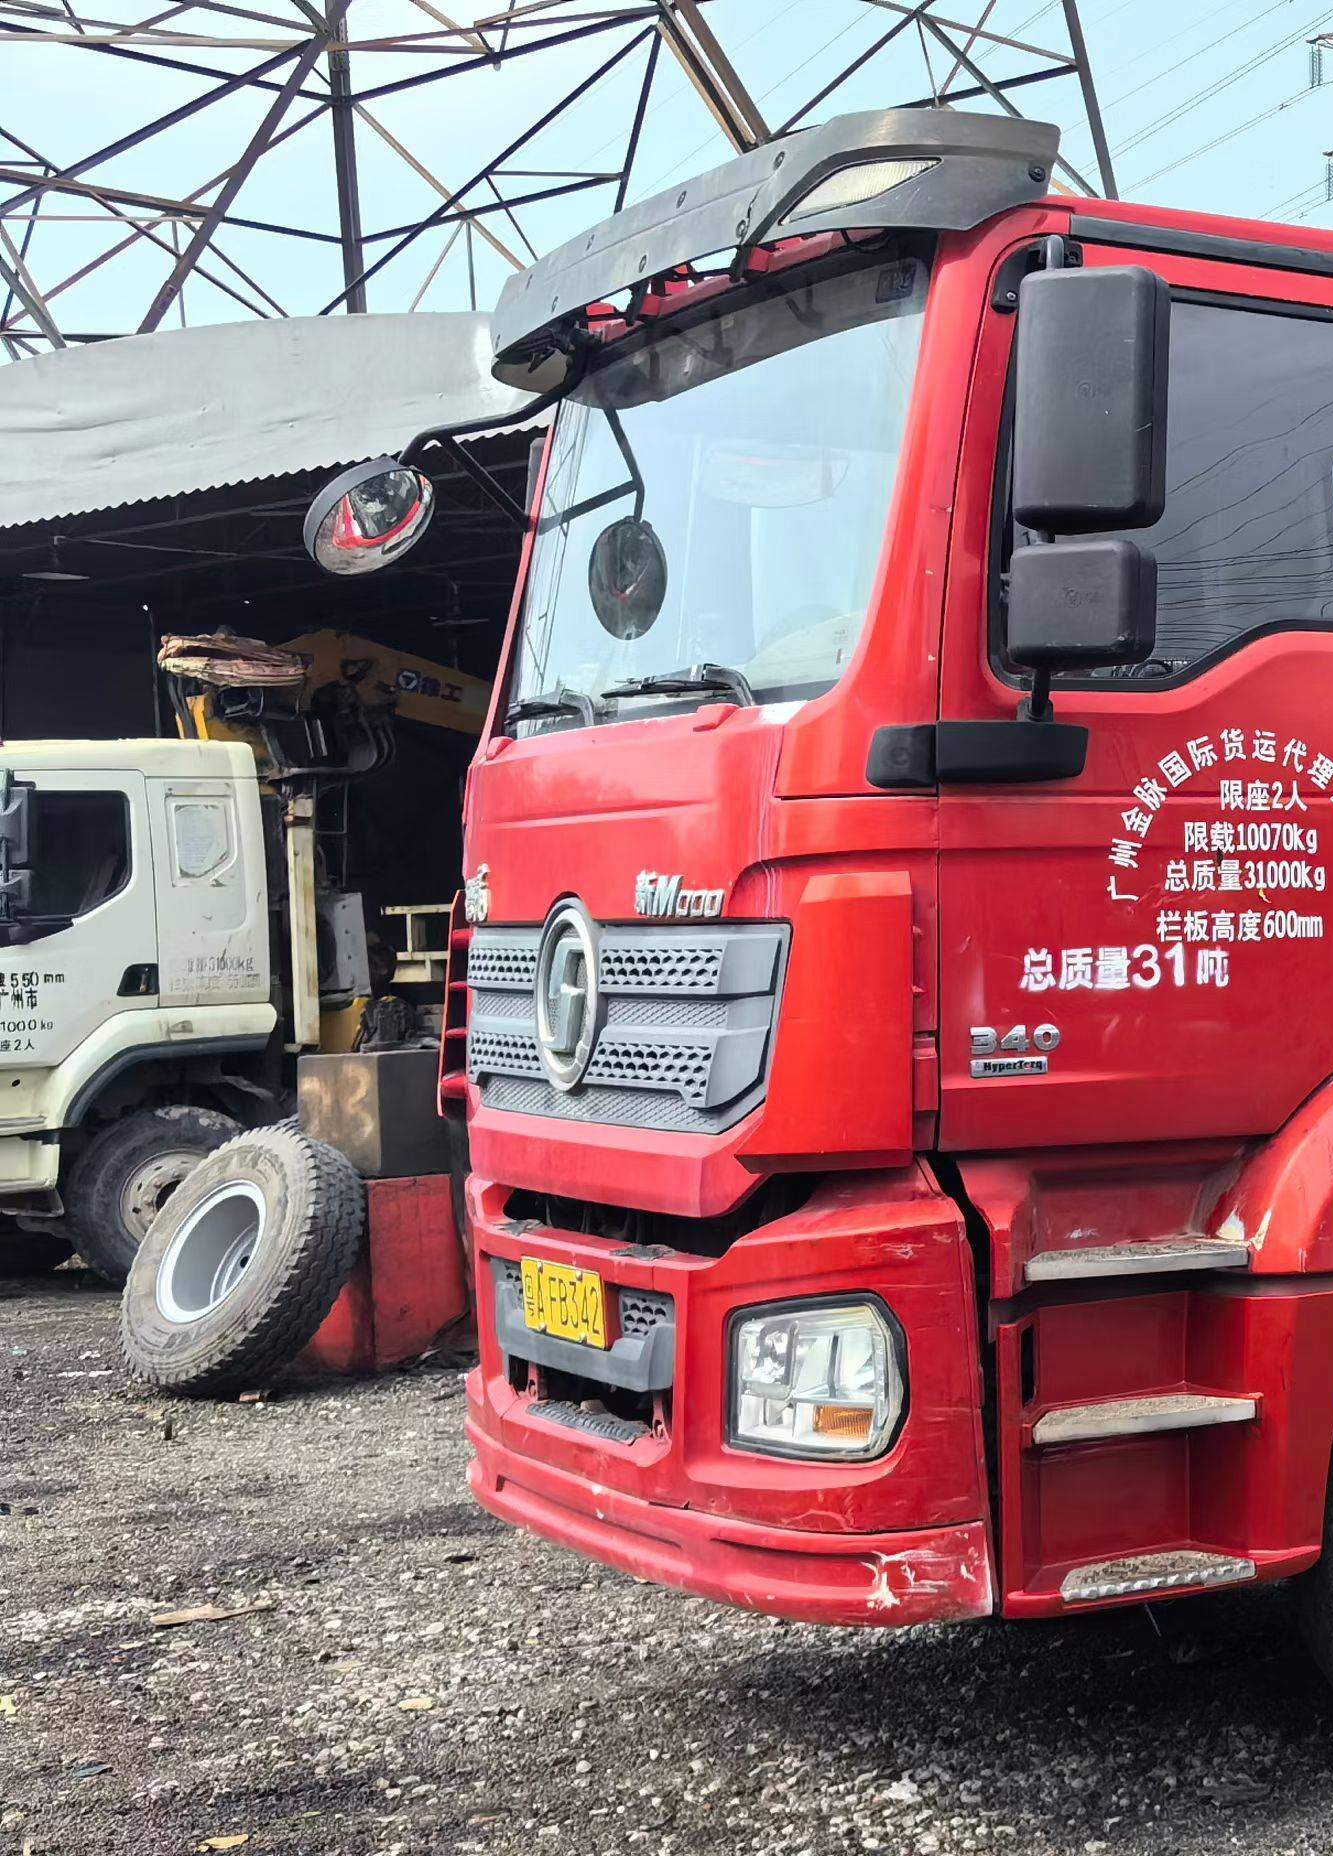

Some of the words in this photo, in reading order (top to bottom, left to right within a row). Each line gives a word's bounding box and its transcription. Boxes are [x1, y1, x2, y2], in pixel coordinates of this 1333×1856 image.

[1219, 779, 1308, 812] 限座2人
[1156, 909, 1324, 943] 栏板高度600mm
[1019, 942, 1230, 991] 总质量31吨
[970, 1023, 1061, 1055] 340
